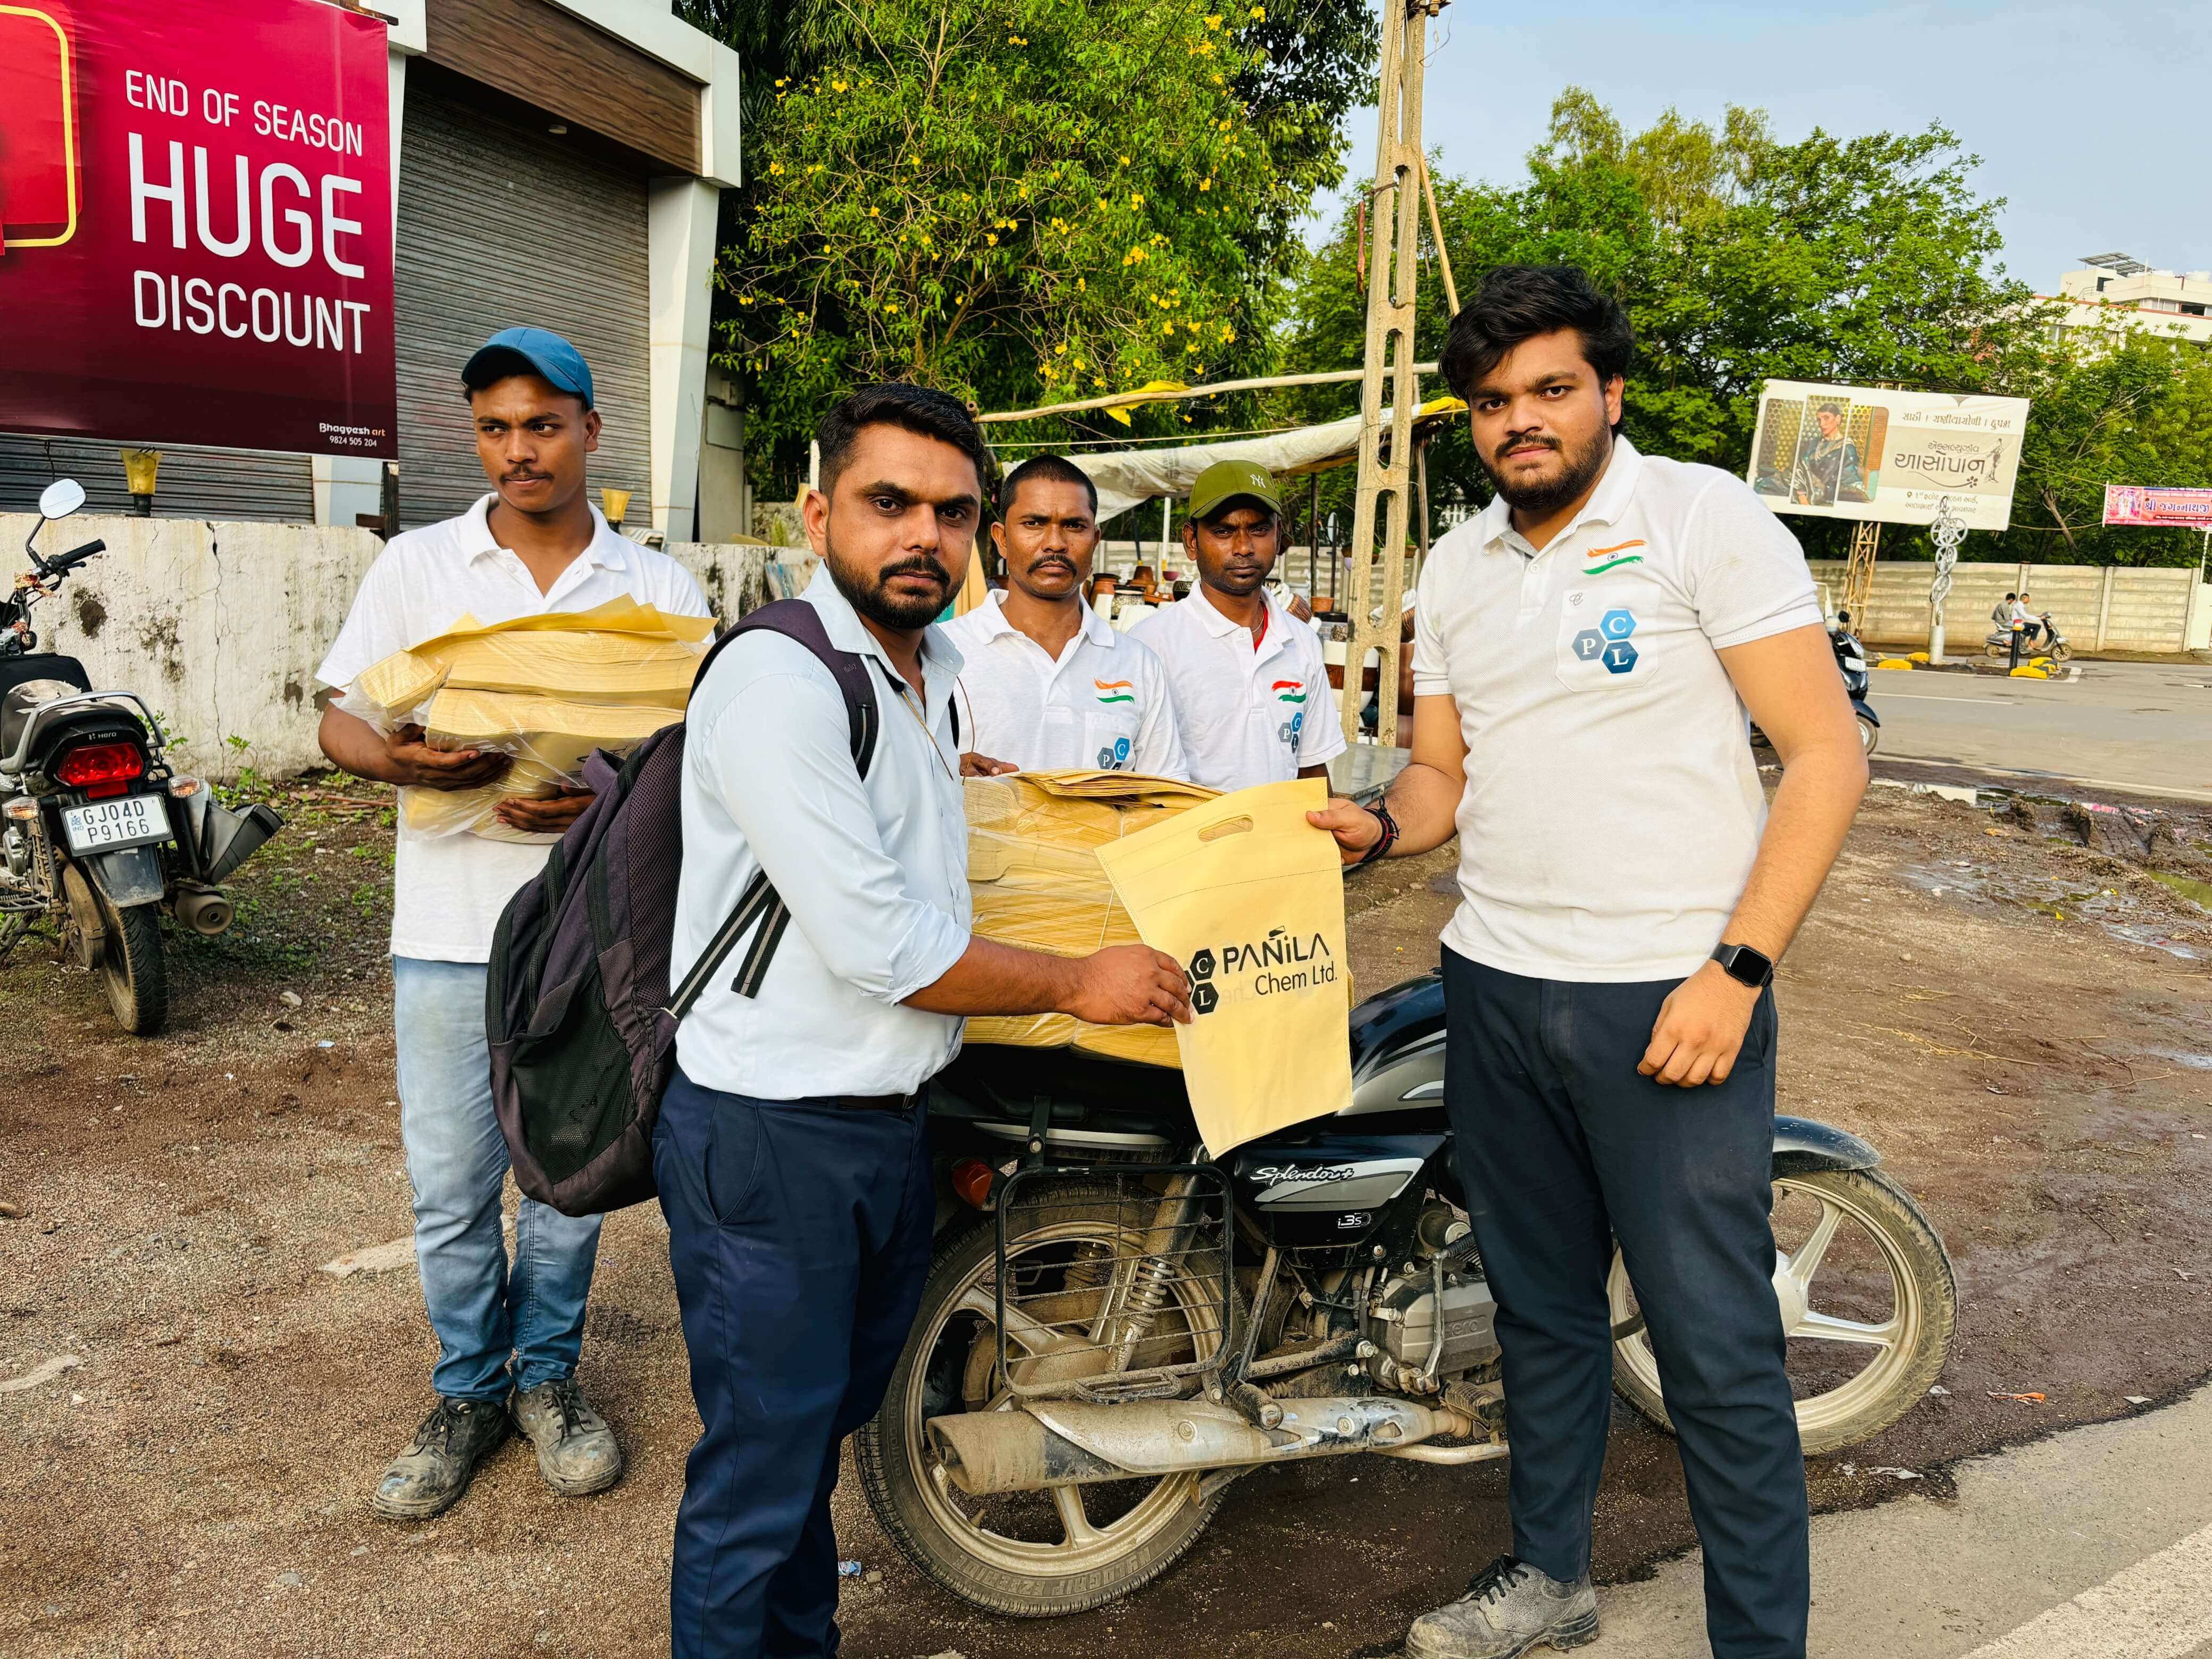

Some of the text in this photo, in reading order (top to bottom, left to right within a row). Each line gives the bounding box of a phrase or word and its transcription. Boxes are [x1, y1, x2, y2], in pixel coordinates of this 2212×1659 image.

[126, 69, 363, 156] END OF SEASON
[128, 132, 365, 279] HUGE
[133, 270, 371, 354] DISCOUNT
[330, 435, 377, 447] 9824 505 204
[1250, 474, 1266, 488] NY
[1608, 617, 1626, 633] C
[1581, 638, 1596, 655] P
[1611, 649, 1629, 666] L
[1295, 718, 1301, 728] C
[1283, 728, 1290, 739] P
[1117, 744, 1126, 756] C
[1102, 754, 1110, 766] P
[83, 801, 144, 825] GJ04D
[87, 819, 149, 843] P9166
[1196, 958, 1209, 975] C
[1255, 960, 1337, 995] Chem Ltd.
[1199, 990, 1211, 1006] L
